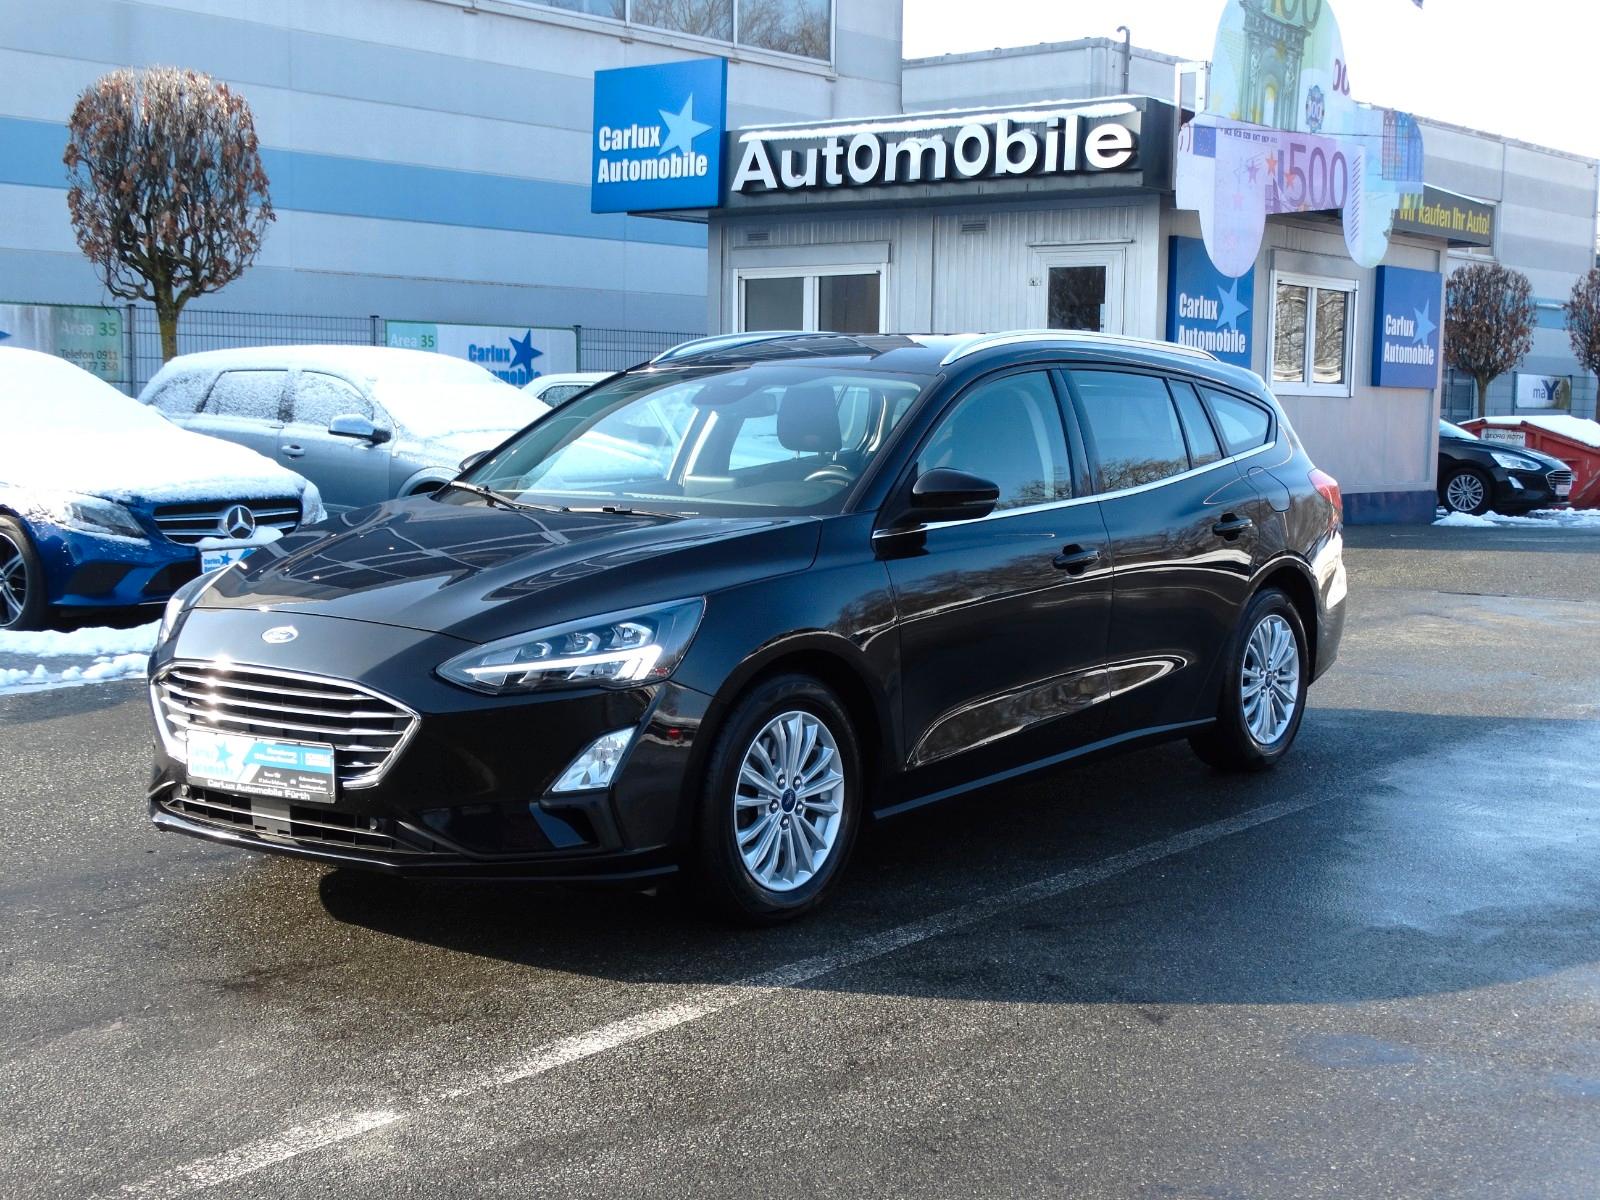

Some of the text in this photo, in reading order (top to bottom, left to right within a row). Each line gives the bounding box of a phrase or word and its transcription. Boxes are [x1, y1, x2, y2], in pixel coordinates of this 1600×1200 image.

[599, 123, 660, 152] Carlux
[597, 152, 708, 183] Automobile
[1289, 142, 1348, 209] 500
[1452, 206, 1466, 231] Ihr
[1466, 209, 1490, 235] Auto!
[1179, 293, 1218, 320] Carlux
[62, 320, 118, 337] Area 35
[1385, 314, 1414, 337] Carlux
[390, 333, 434, 348] Area 35
[1177, 325, 1246, 354] Automobile
[468, 344, 511, 363] Carlux
[1383, 341, 1434, 366] Automobile
